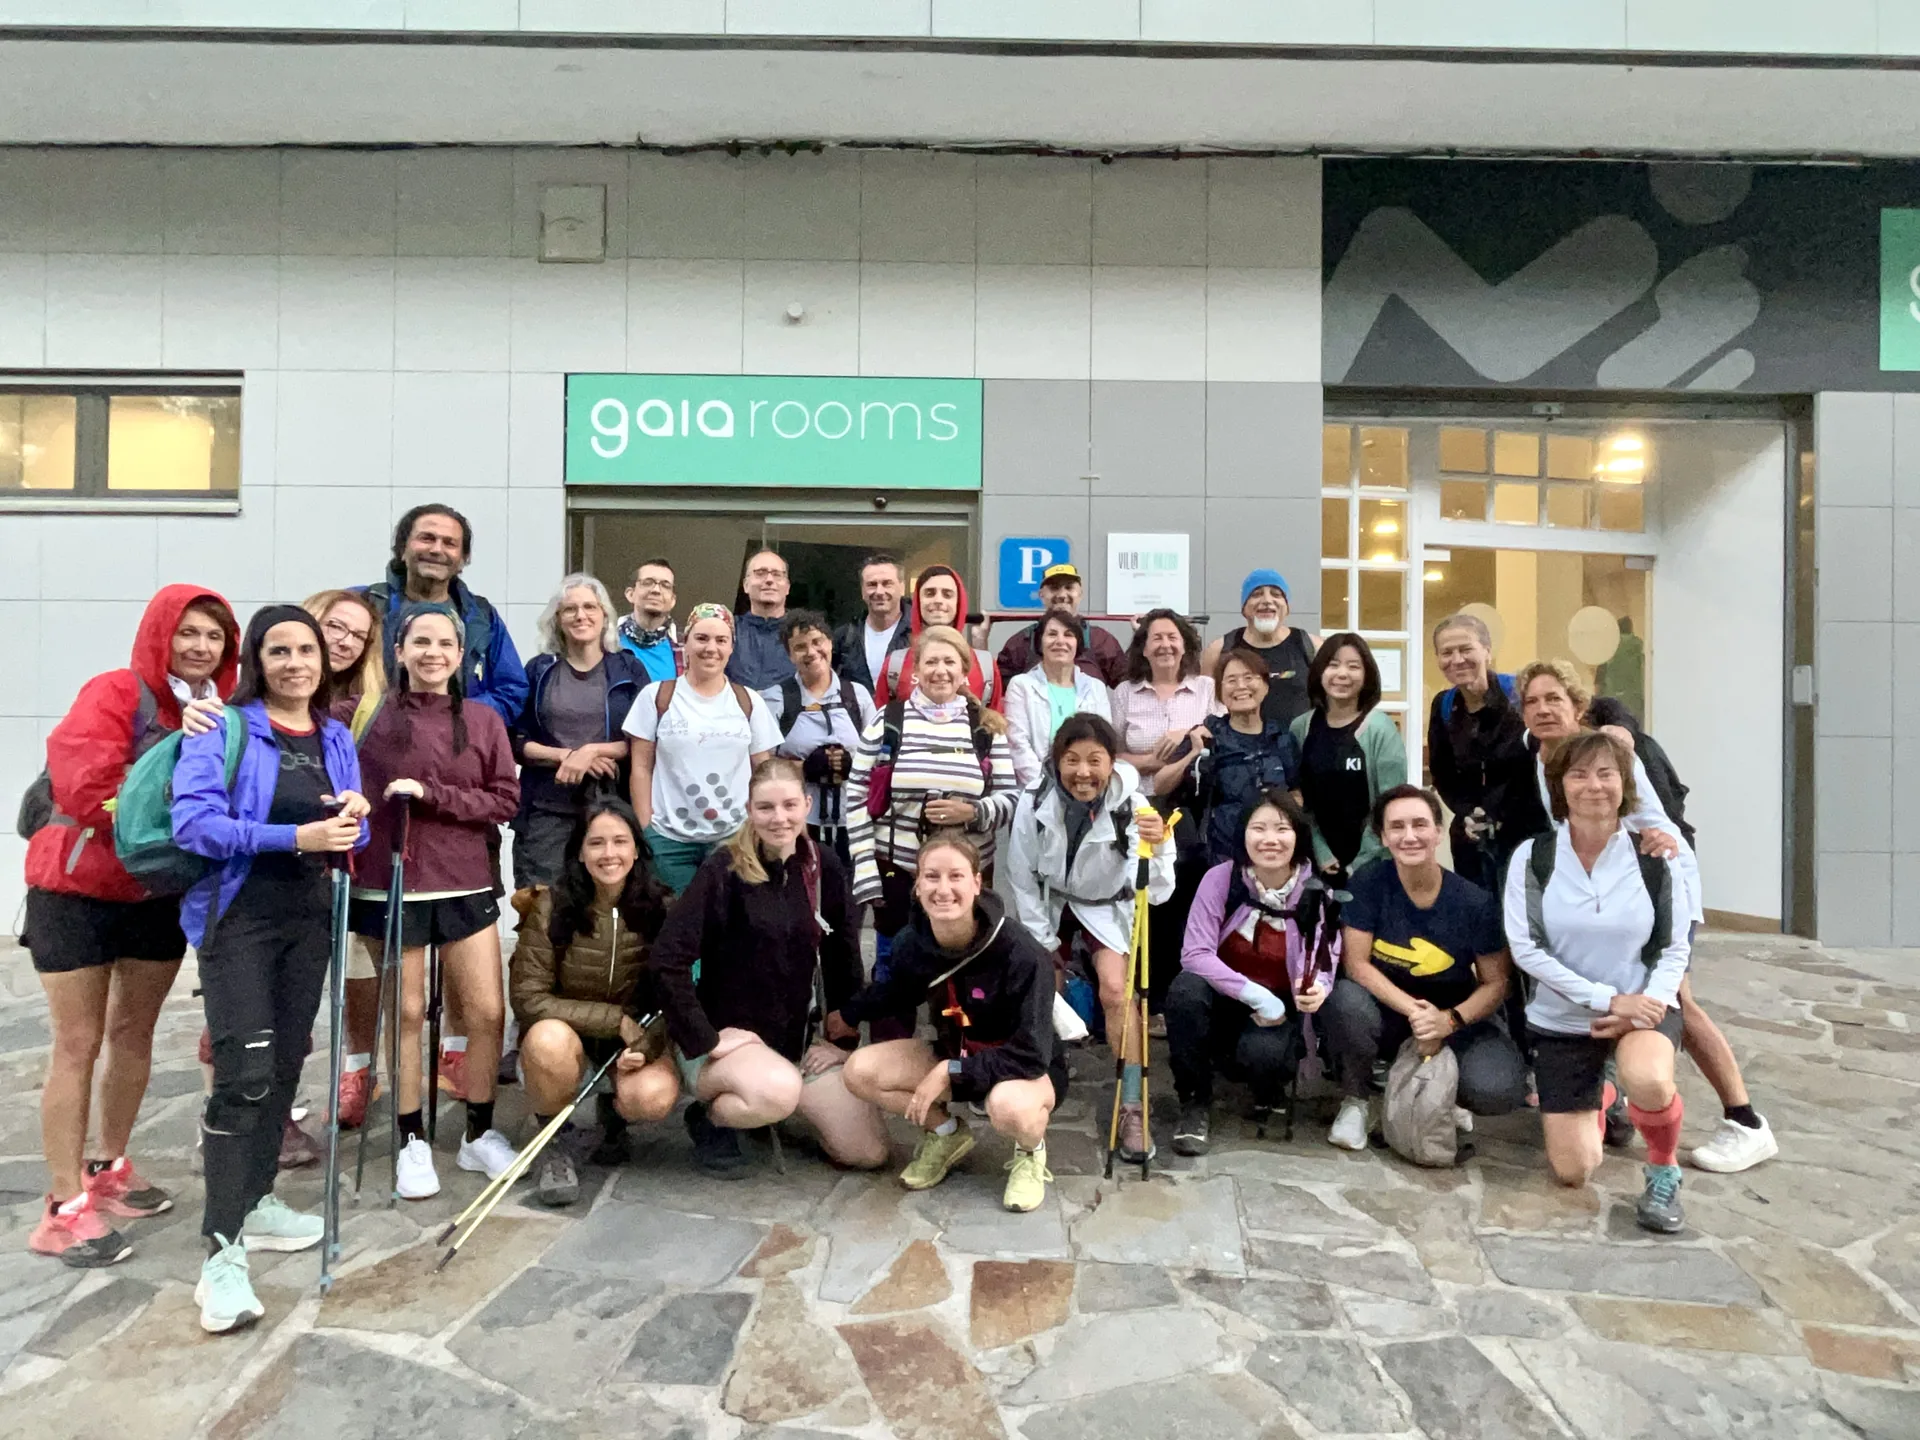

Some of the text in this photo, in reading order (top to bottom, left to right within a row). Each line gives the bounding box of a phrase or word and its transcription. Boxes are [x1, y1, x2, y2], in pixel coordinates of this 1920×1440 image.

[590, 397, 959, 459] gaia rooms
[1017, 546, 1053, 585] P
